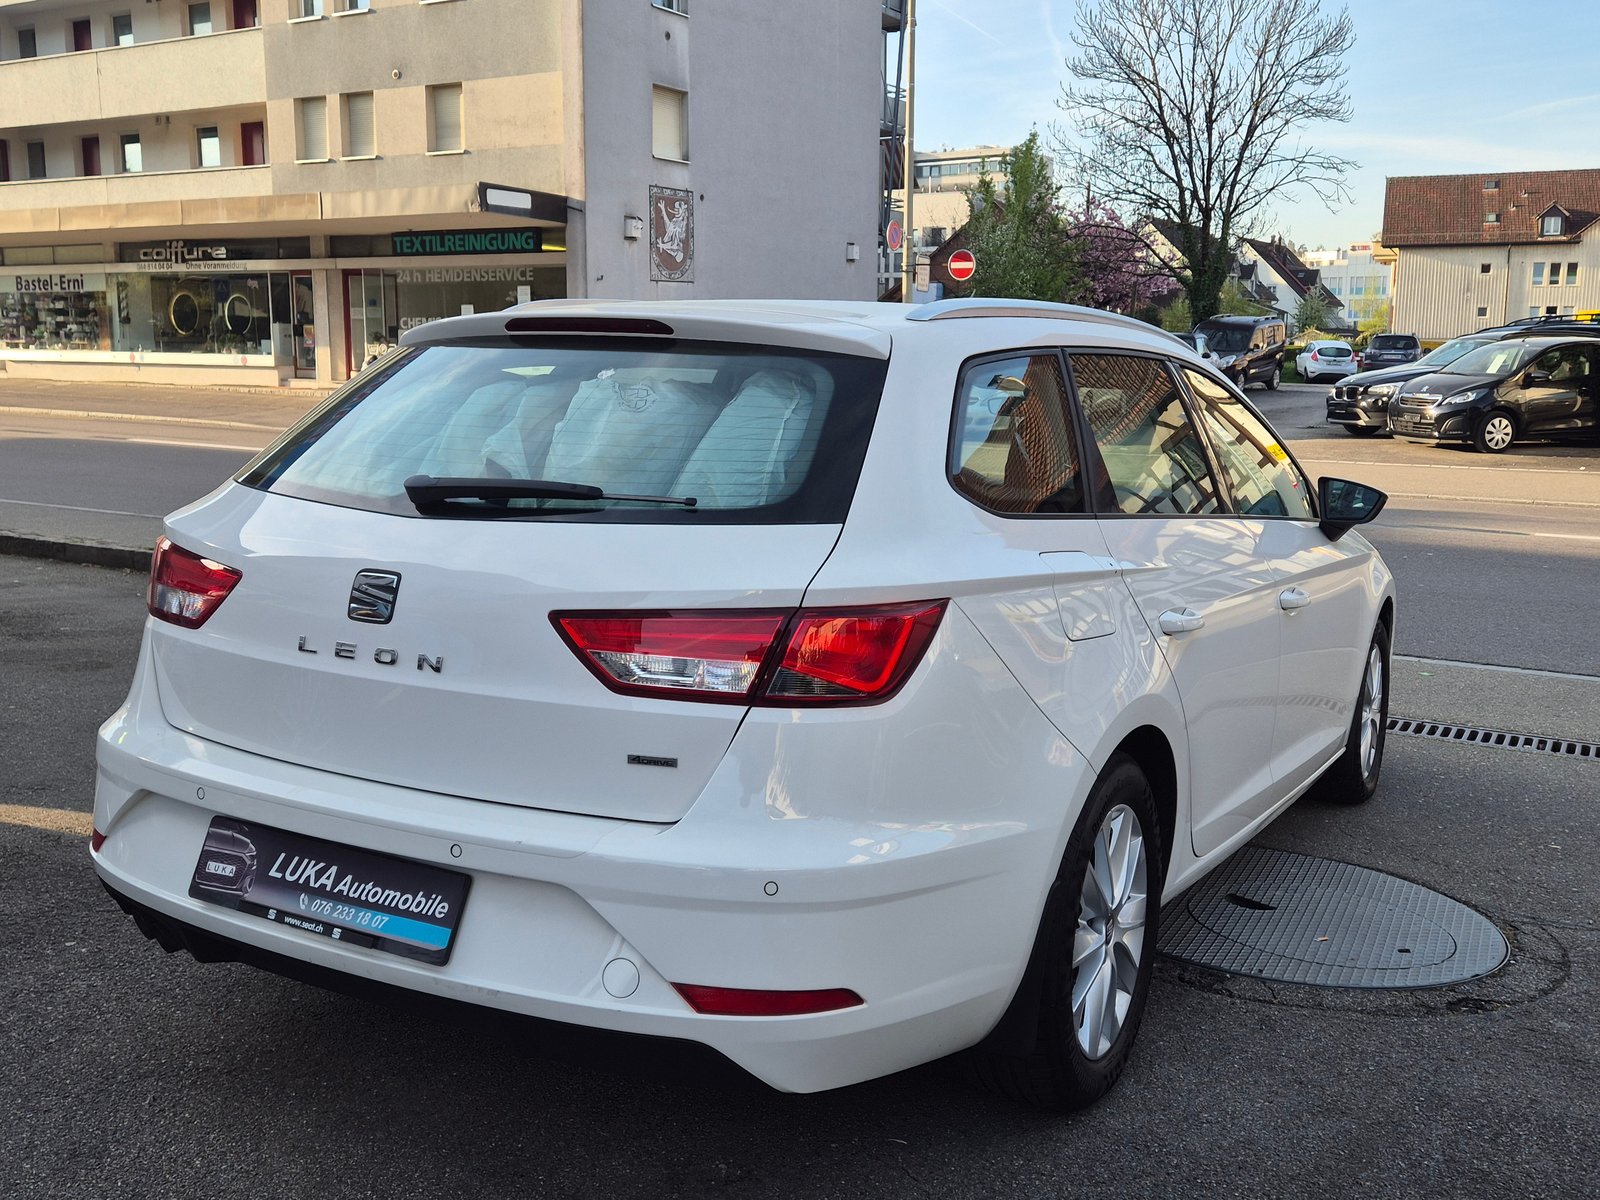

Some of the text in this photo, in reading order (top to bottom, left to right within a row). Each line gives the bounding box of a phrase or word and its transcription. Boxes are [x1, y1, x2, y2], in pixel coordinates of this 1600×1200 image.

[394, 232, 534, 253] TEXTILREINIGUNG
[140, 241, 226, 263] coiffure
[185, 261, 248, 271] Ohne Voranmeldung
[397, 267, 534, 283] 24 h HEMDENSERVICE
[15, 274, 84, 292] Bastel-Erni
[298, 635, 443, 673] LEON
[630, 755, 675, 768] 4DRIVE
[207, 862, 235, 875] LUKA
[268, 853, 449, 918] LUKA Automobile
[311, 899, 389, 929] 076 233 18 07
[284, 916, 324, 934] www.seat.ch
